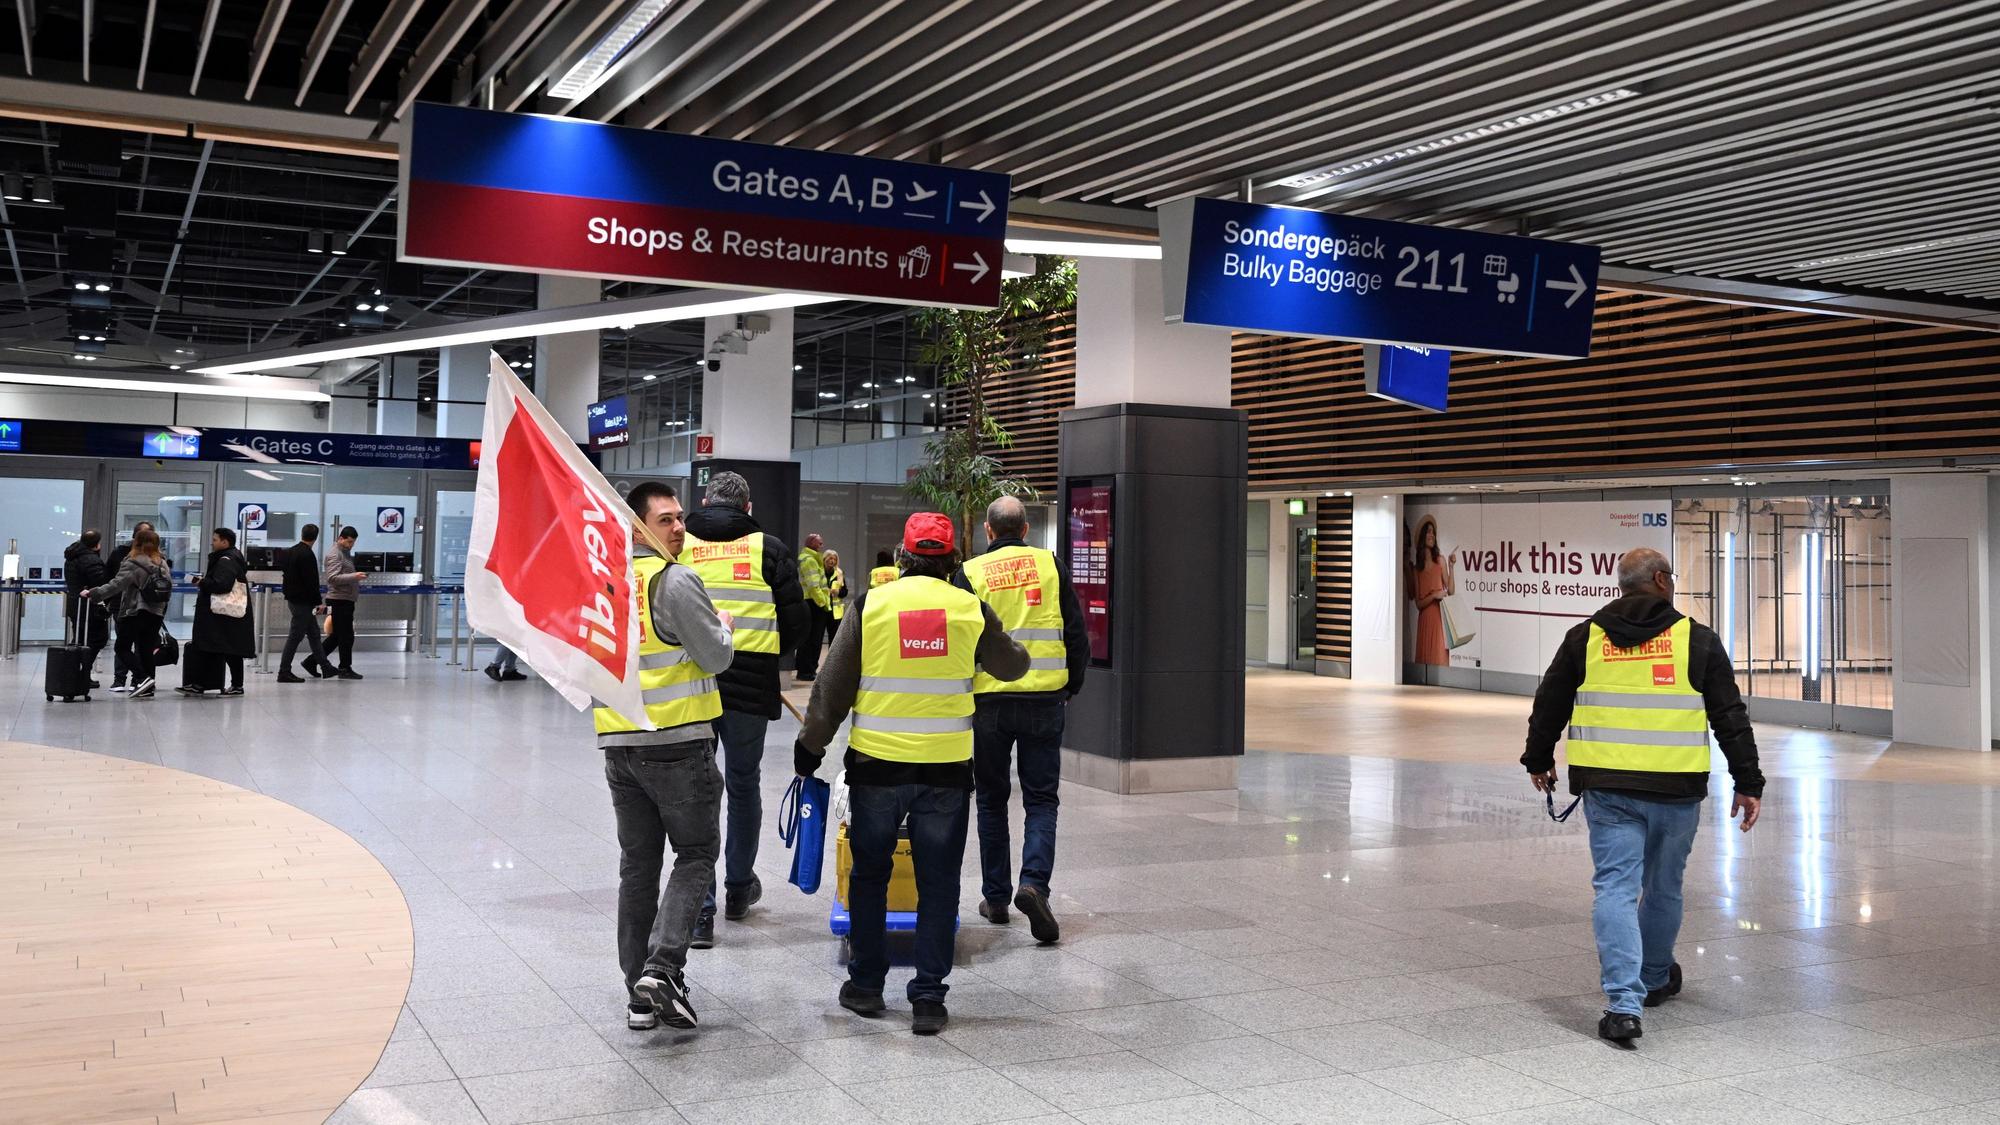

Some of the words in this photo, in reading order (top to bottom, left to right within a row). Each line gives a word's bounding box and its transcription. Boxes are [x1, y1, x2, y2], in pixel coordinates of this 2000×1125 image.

[712, 160, 820, 201] Gates
[587, 217, 683, 255] Shops
[692, 228, 713, 253] &
[723, 230, 889, 269] Restaurants
[1224, 220, 1385, 260] Sondergepäck
[1223, 253, 1284, 288] Bulky
[1288, 260, 1382, 295] Baggage
[1395, 246, 1469, 294] 211
[251, 436, 312, 455] Gates
[318, 439, 333, 455] C
[350, 442, 377, 452] Zugang
[378, 443, 395, 451] auch
[406, 444, 426, 452] Gates
[1642, 513, 1667, 526] DUS
[692, 545, 719, 559] GEHT
[723, 543, 750, 556] MEHR
[1462, 541, 1522, 573] walk
[1529, 541, 1583, 575] this
[578, 482, 617, 656] ver.di
[984, 558, 1036, 576] ZUSAMMEN
[987, 573, 1011, 588] GEHT
[1014, 569, 1039, 585] MEHR
[1465, 579, 1476, 592] to
[1479, 581, 1498, 592] our
[1500, 578, 1538, 597] shops
[1542, 580, 1551, 594] &
[1555, 582, 1620, 598] restauran
[903, 638, 945, 650] ver.di
